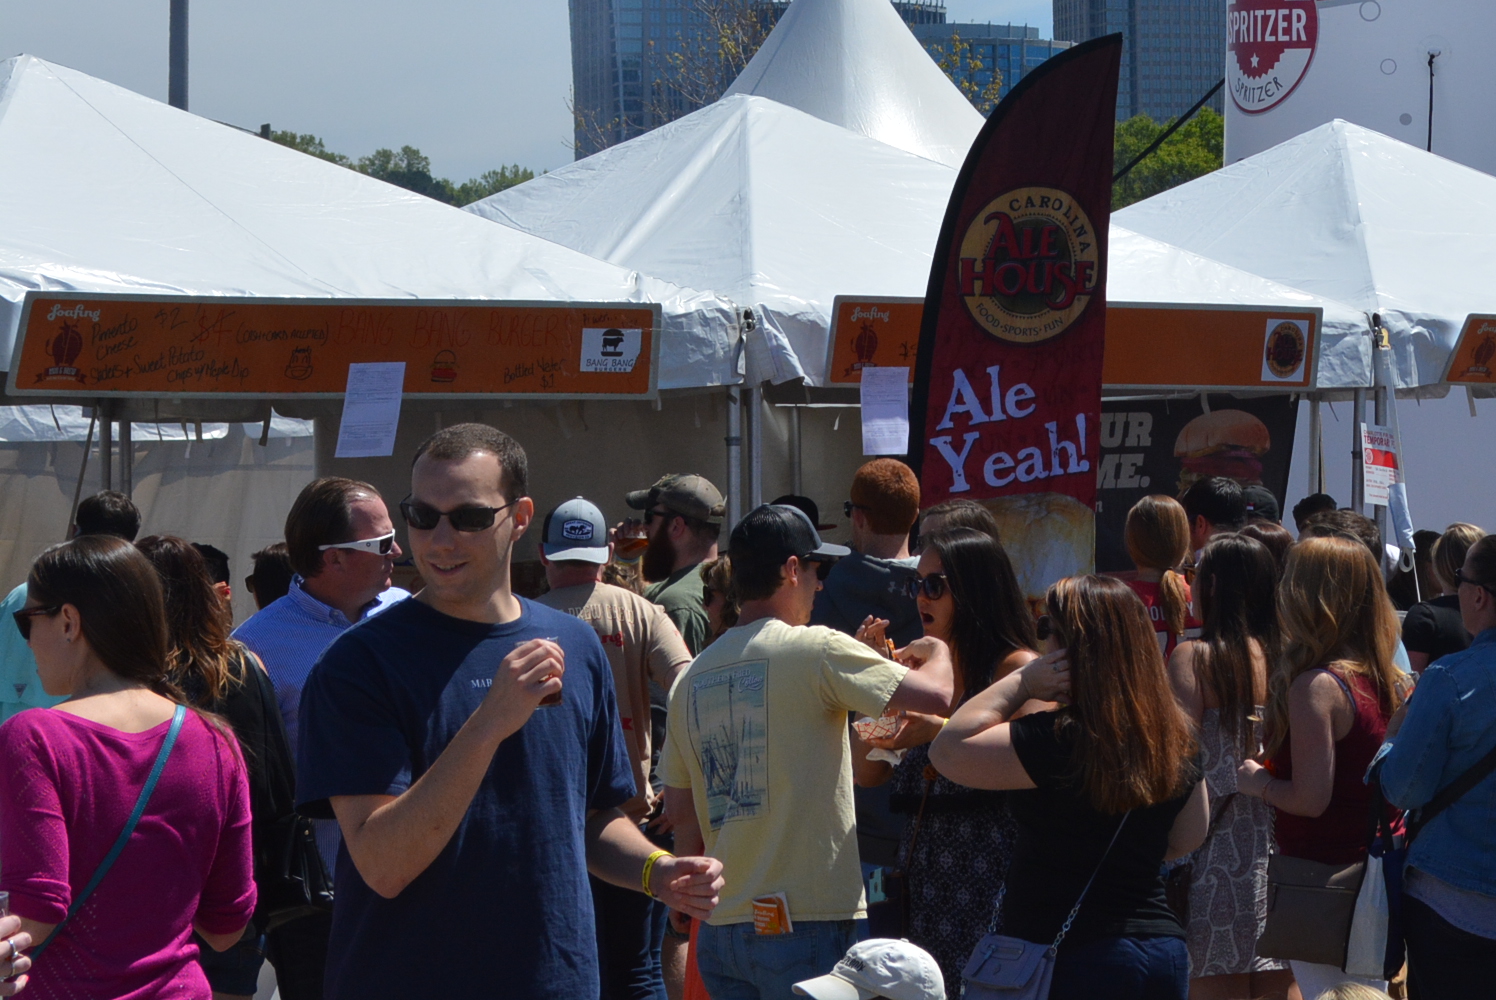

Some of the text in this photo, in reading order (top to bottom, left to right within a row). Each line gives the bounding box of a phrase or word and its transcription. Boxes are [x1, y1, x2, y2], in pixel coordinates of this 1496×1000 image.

[1228, 8, 1307, 44] SPRITZER
[1235, 76, 1284, 104] SPRITZER
[983, 211, 1058, 260] ALE
[1009, 195, 1092, 254] CAROLINA
[959, 257, 1096, 312] HOUSE
[334, 308, 573, 350] BANG BANG BURGERS
[975, 302, 1001, 329] FOOD
[1043, 316, 1065, 333] FUN
[231, 357, 250, 386] Dip
[586, 358, 634, 367] BANG BANG
[935, 365, 1036, 431] Ale
[929, 412, 1090, 493] Yeah!
